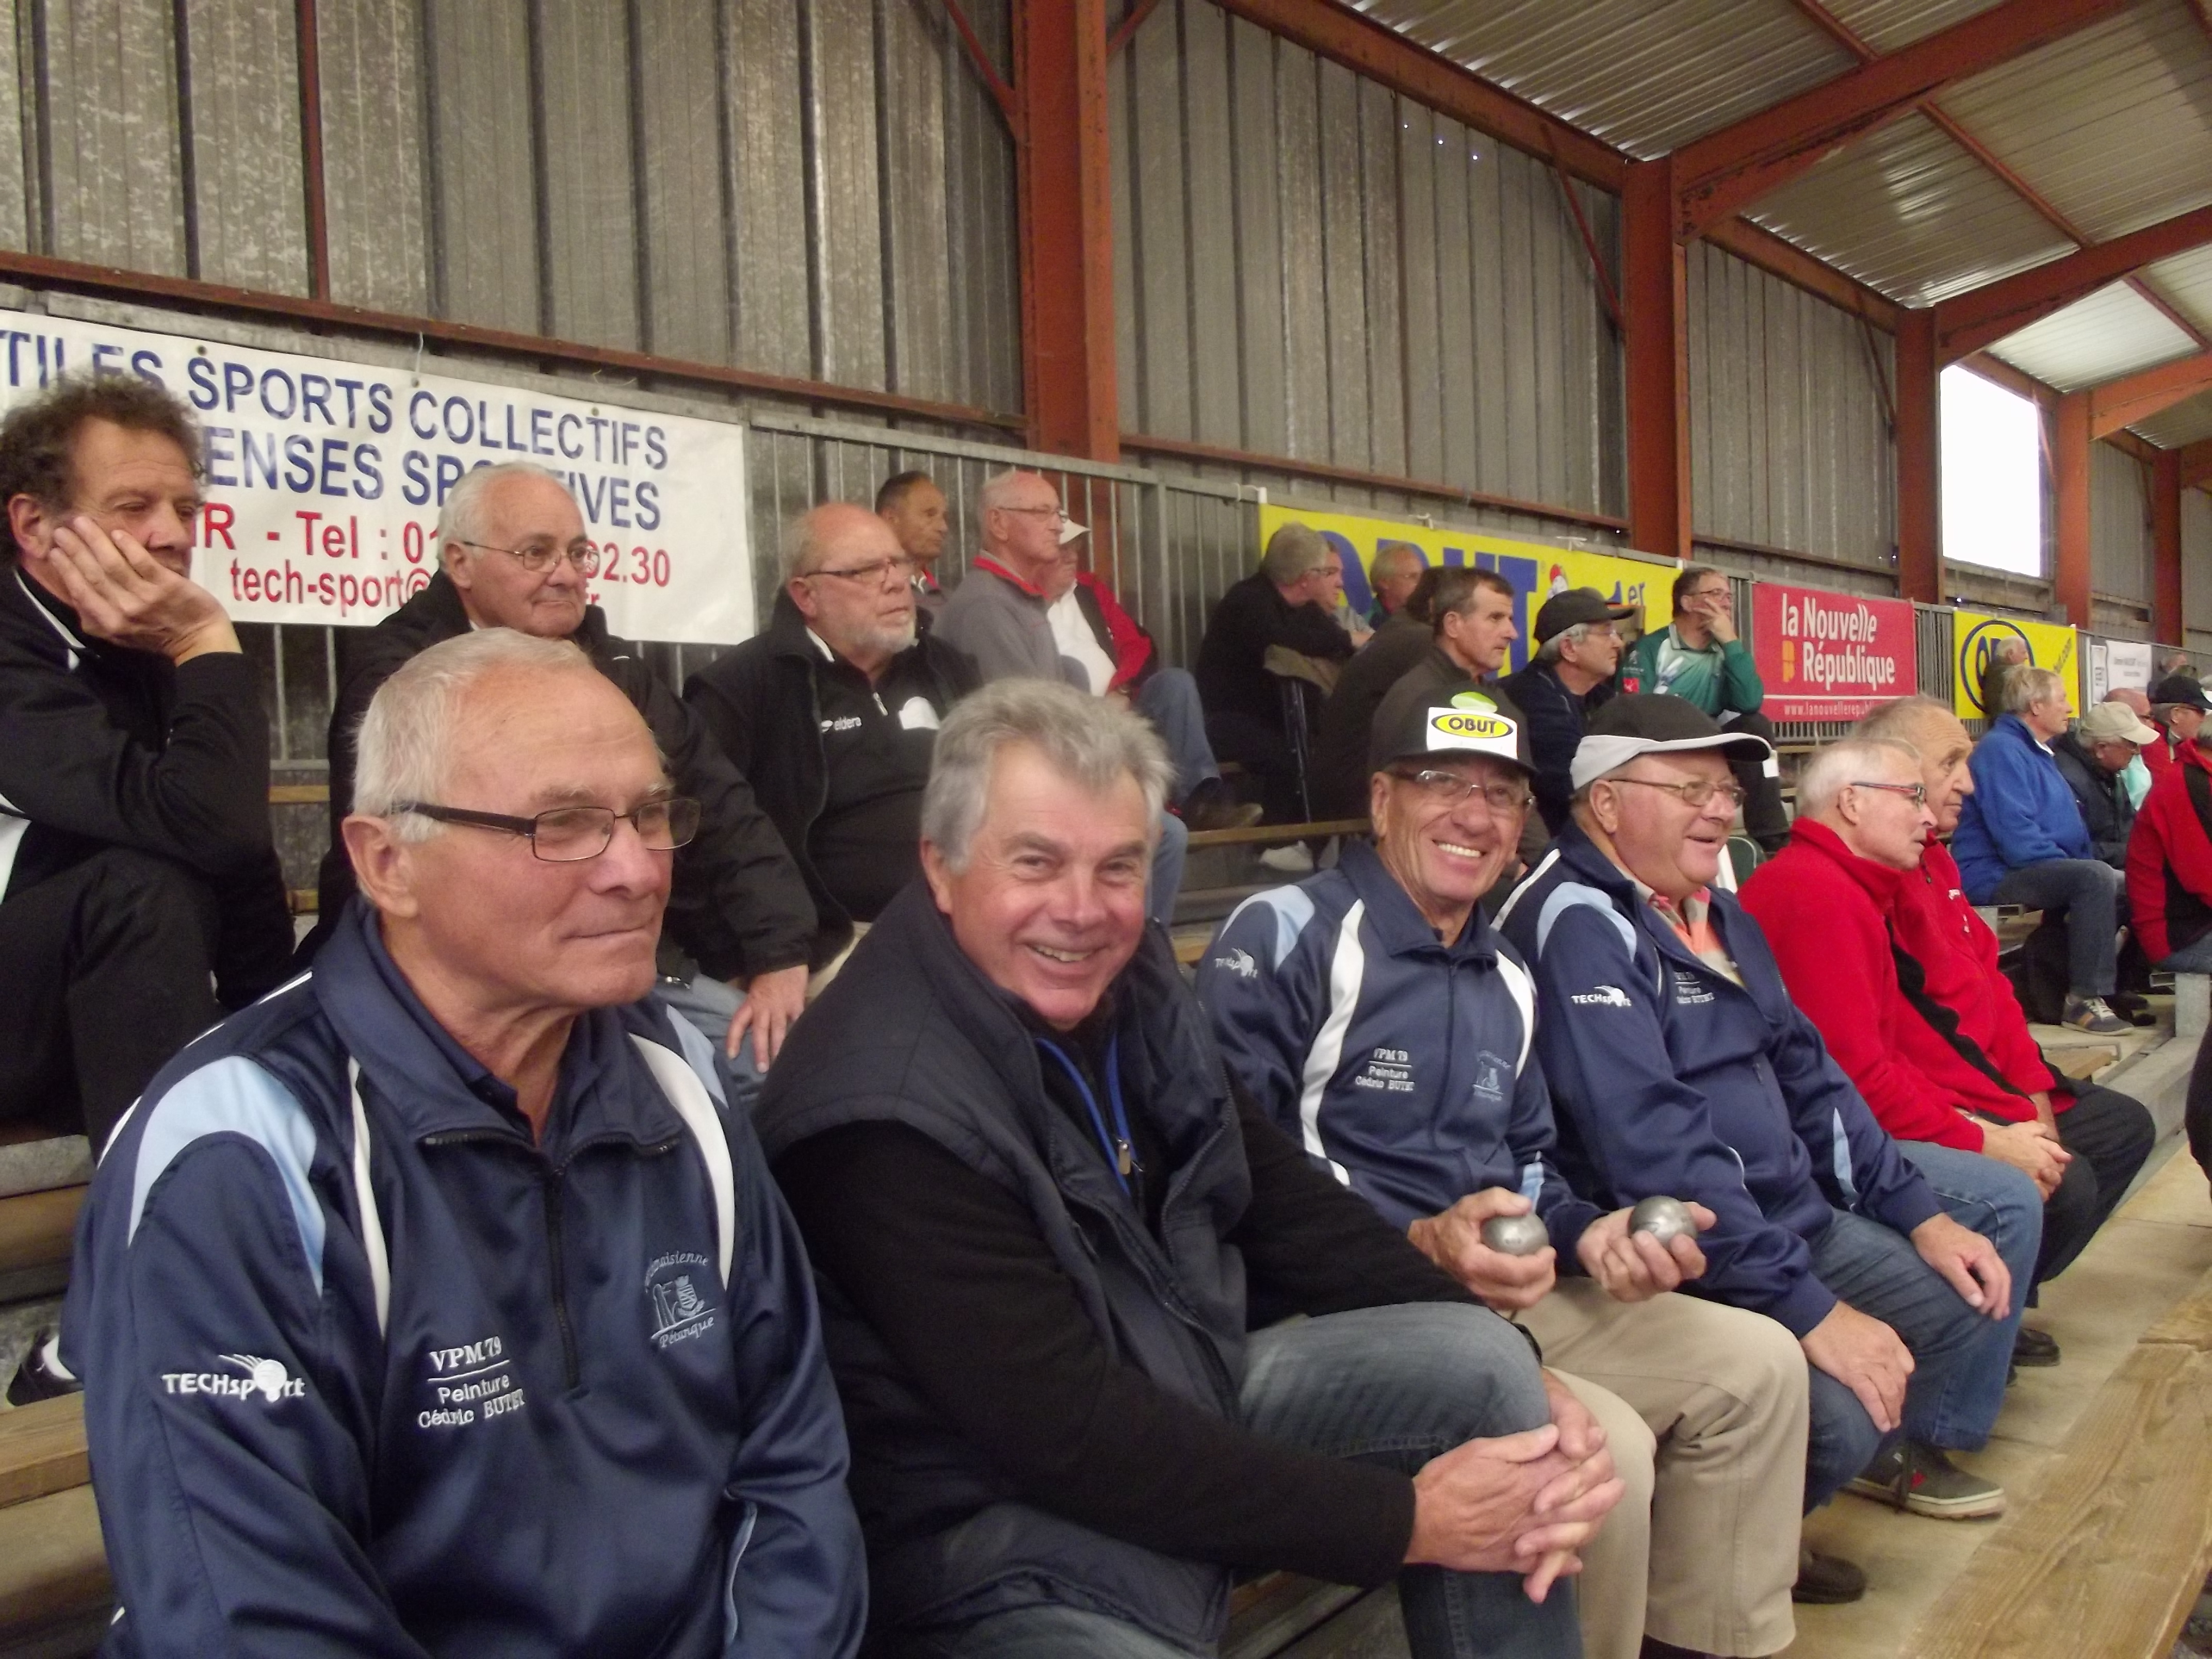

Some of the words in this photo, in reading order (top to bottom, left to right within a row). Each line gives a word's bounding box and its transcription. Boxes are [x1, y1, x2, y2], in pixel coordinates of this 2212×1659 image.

[187, 356, 393, 434] SPORTS
[409, 391, 668, 470] COLLECTIFS
[296, 511, 359, 559] Tel
[1781, 593, 1799, 637] la
[1803, 596, 1878, 643] Nouvelle
[1802, 641, 1895, 691] République
[1448, 716, 1497, 734] OBUT
[429, 1341, 486, 1372] VPM
[484, 1335, 502, 1357] 79
[418, 1408, 475, 1428] Cédric
[482, 1388, 526, 1419] BUTET
[437, 1374, 510, 1404] Peinture
